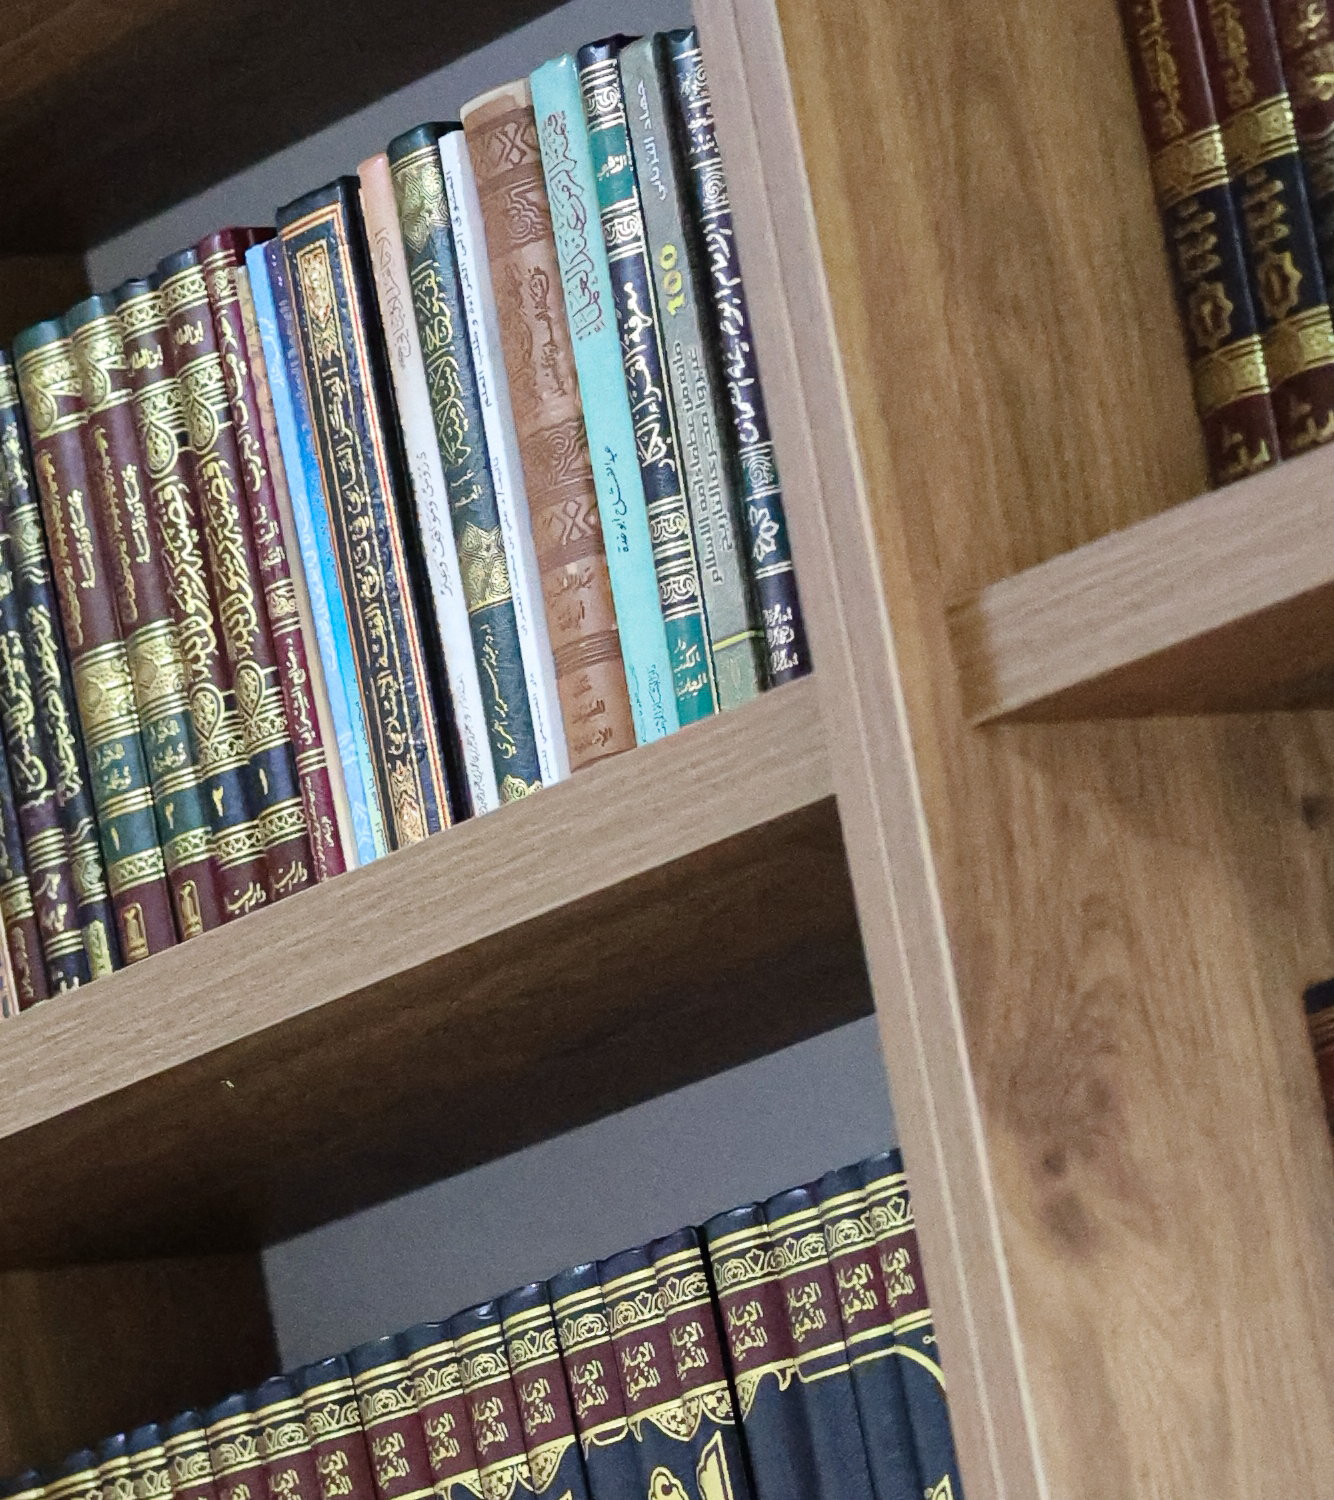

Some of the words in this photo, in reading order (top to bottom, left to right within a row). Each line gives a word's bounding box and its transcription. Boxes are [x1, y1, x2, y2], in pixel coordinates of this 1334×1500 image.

[409, 254, 453, 354] الفتوح
[618, 274, 654, 346] معرفة
[637, 408, 676, 483] الكبار
